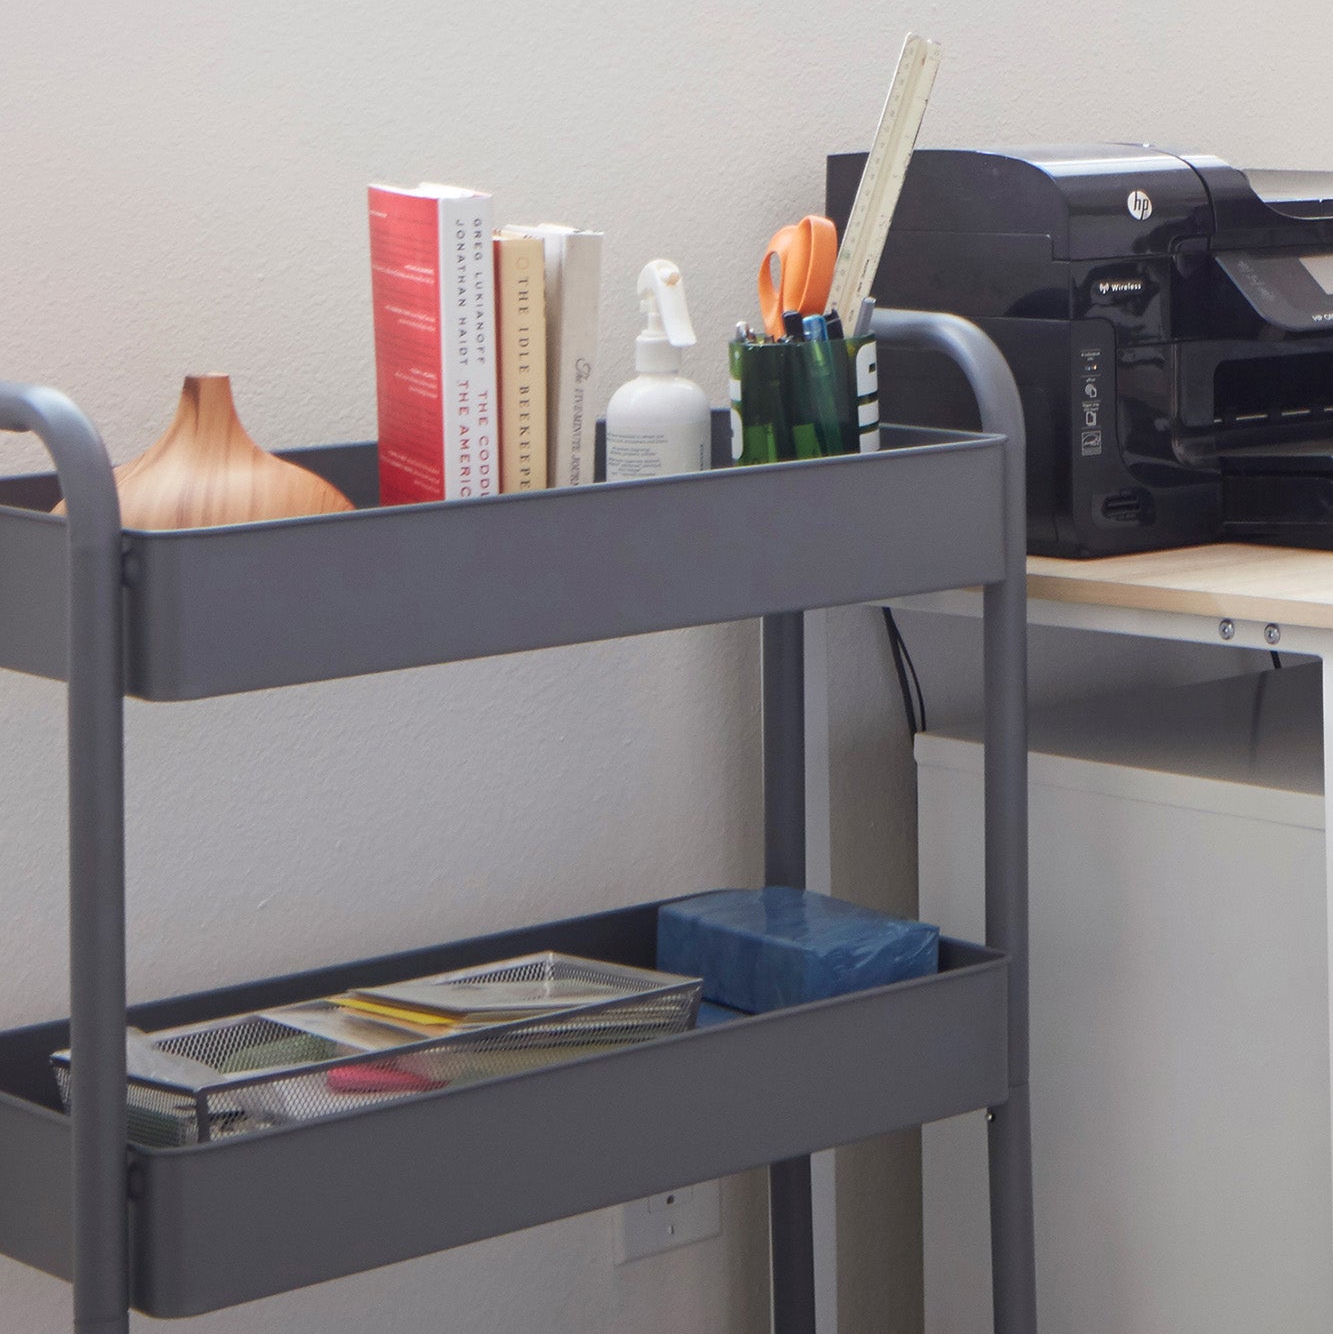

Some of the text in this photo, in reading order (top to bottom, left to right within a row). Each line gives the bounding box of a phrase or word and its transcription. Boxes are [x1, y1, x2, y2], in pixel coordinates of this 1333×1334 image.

[1133, 191, 1149, 219] hp
[455, 219, 468, 366] JONATHAN HAIDT
[473, 217, 486, 365] GREG LUKIANOFF
[518, 277, 529, 315] THE
[1111, 283, 1142, 291] Wireless
[518, 327, 529, 372] IDLE
[575, 357, 591, 385] The
[458, 380, 470, 416] THE
[478, 391, 488, 426] THE
